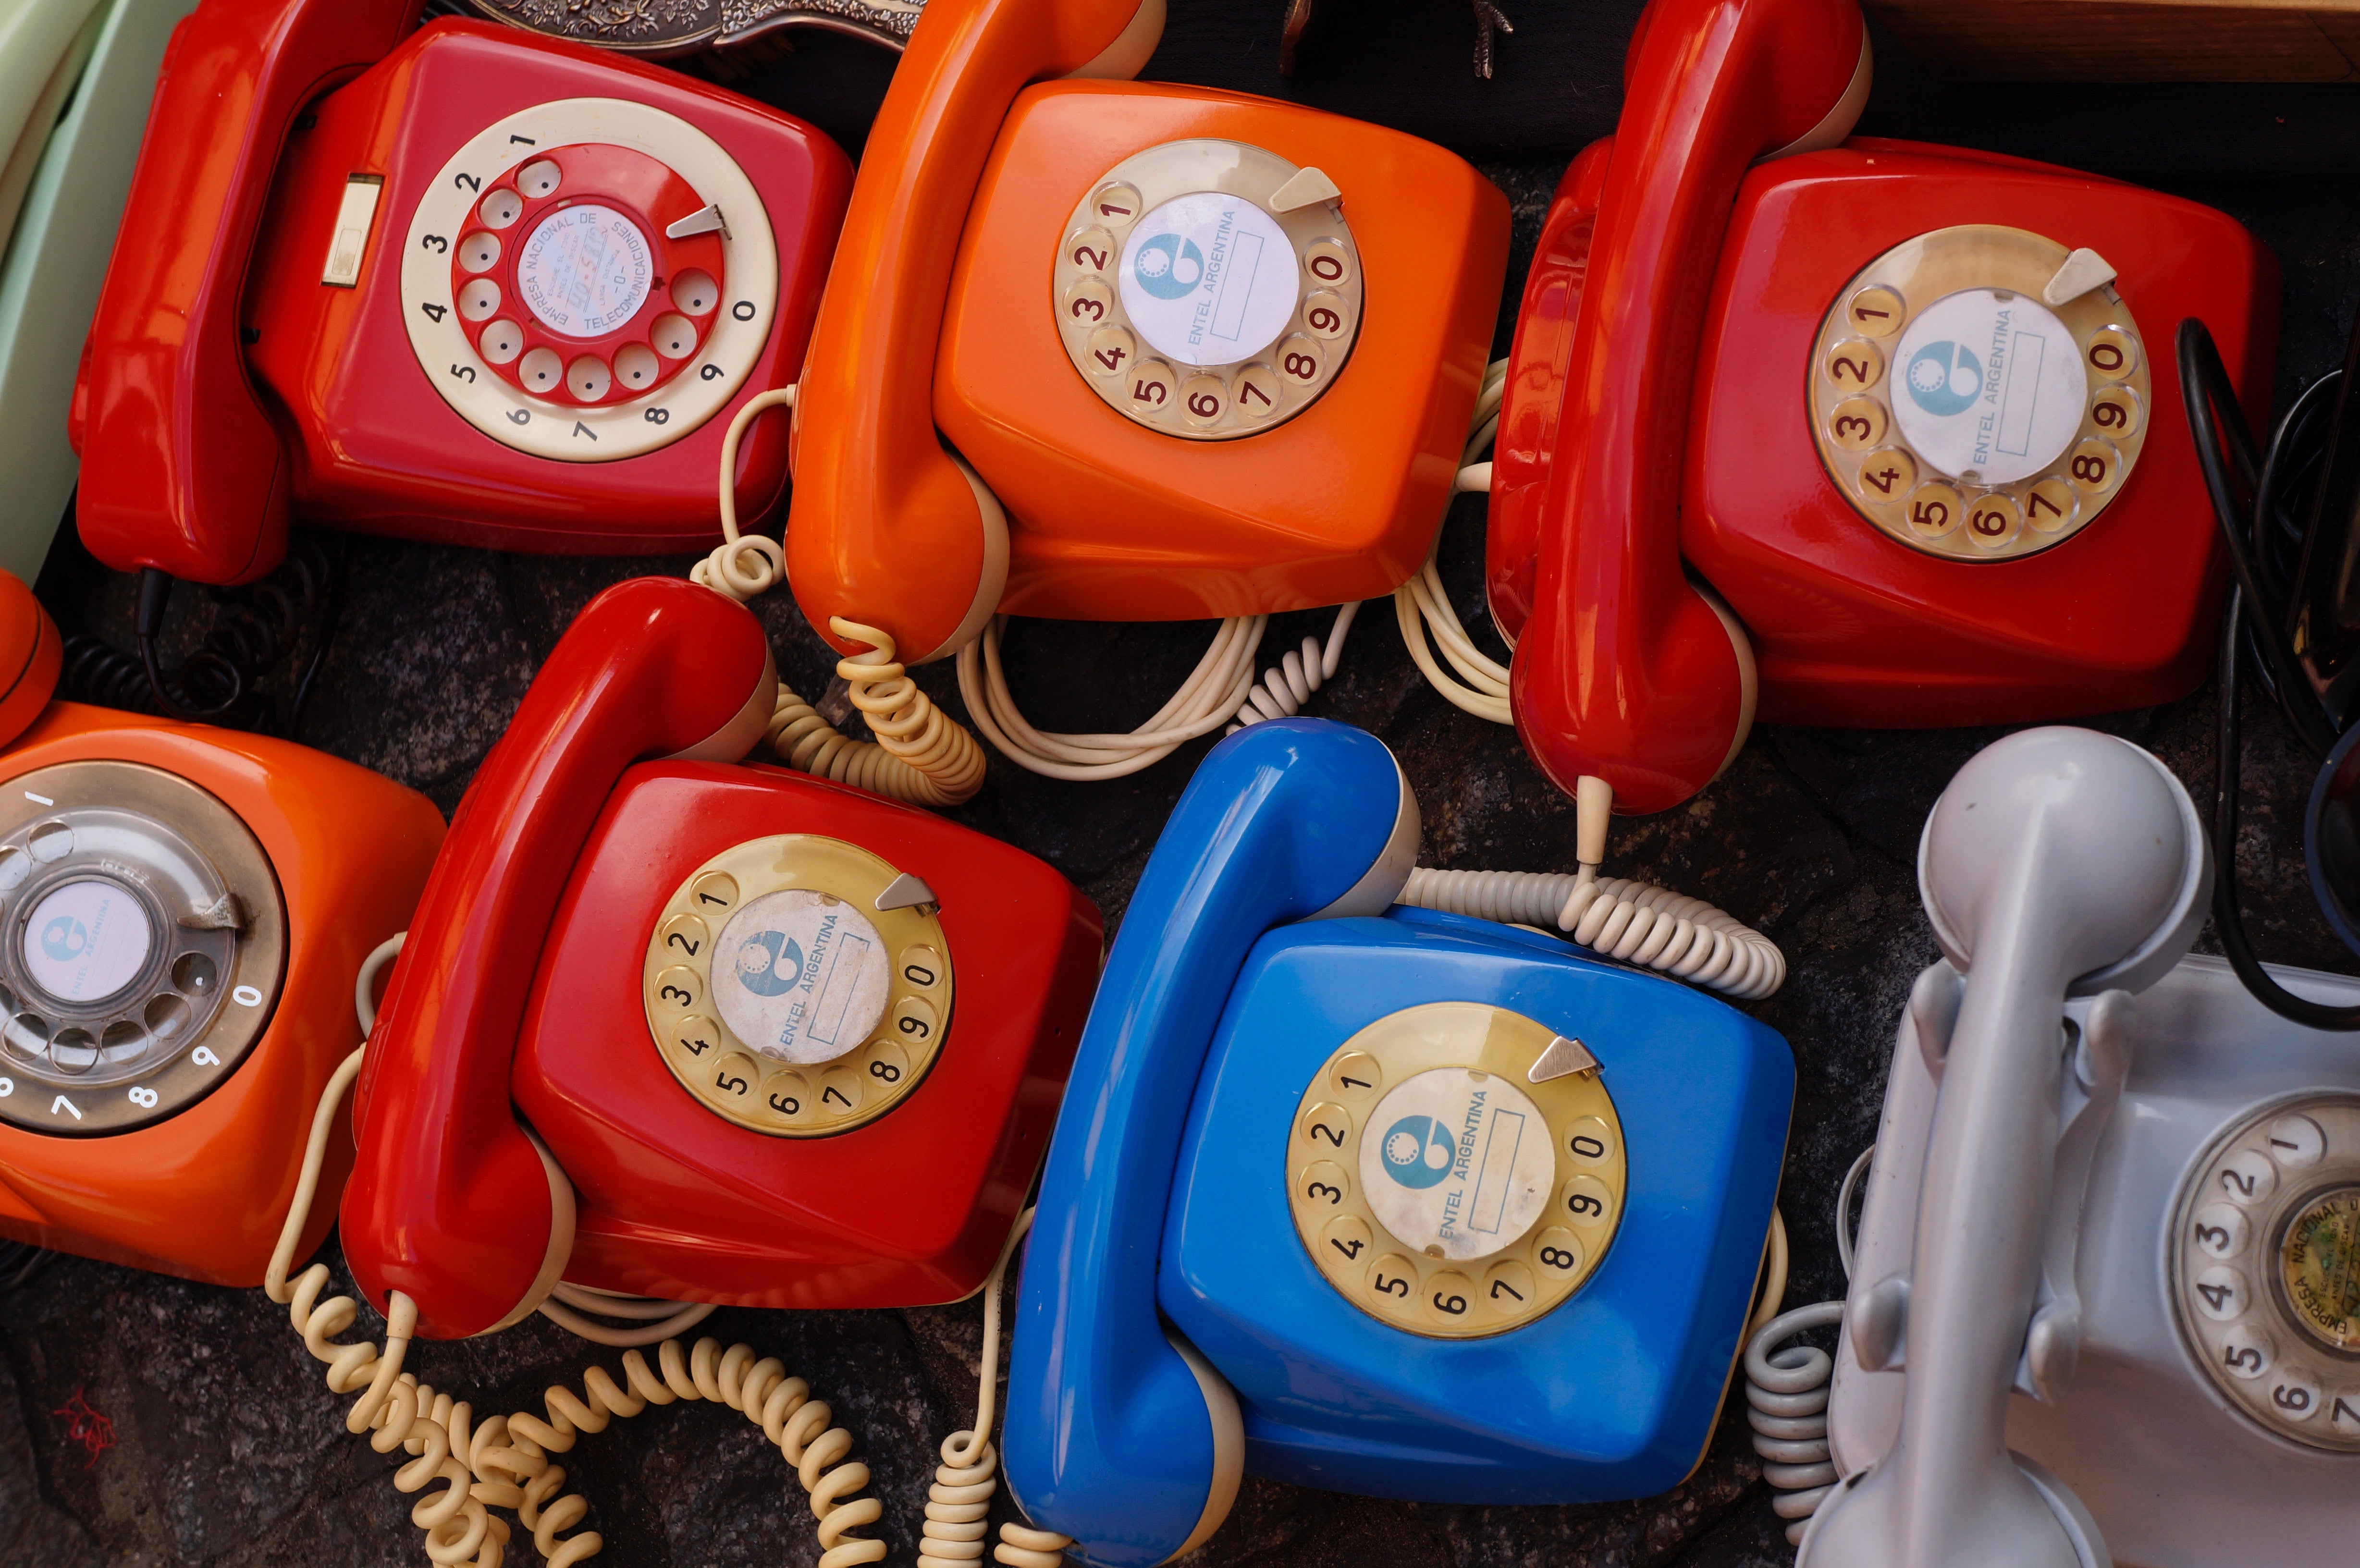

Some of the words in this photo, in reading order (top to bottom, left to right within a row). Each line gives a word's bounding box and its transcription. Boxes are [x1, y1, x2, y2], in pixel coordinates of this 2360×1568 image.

[510, 135, 536, 146] 1
[455, 173, 481, 193] 2
[580, 213, 596, 224] DE
[1100, 203, 1131, 217] 1
[422, 234, 448, 254] 3
[526, 217, 574, 270] NACIONAL
[565, 265, 572, 273] DE
[1074, 246, 1108, 271] 2
[1311, 256, 1343, 281] 0
[584, 221, 645, 330] TELECOMUNICACIONES
[1188, 299, 1212, 345] ENTEL
[1203, 210, 1235, 293] ARGENTINA
[421, 302, 448, 323] 4
[527, 276, 568, 325] EMPRESA
[732, 301, 756, 321] 0
[1072, 298, 1104, 322] 3
[1309, 307, 1340, 333] 9
[1855, 307, 1890, 321] 1
[1094, 347, 1126, 371] 4
[1284, 352, 1316, 380] 8
[2089, 343, 2123, 371] 0
[450, 364, 476, 384] 5
[700, 364, 725, 381] 9
[1832, 357, 1868, 383] 2
[1133, 380, 1167, 405] 5
[1239, 380, 1271, 407] 7
[1972, 412, 1995, 465] ENTEL
[1984, 309, 2011, 405] ARGENTINA
[644, 407, 669, 425] 8
[1188, 392, 1219, 417] 6
[2092, 402, 2127, 429] 9
[505, 409, 531, 426] 6
[1835, 416, 1871, 441] 3
[572, 420, 598, 441] 7
[1865, 467, 1900, 494] 4
[2071, 455, 2106, 484] 8
[1913, 501, 1948, 527] 5
[2028, 492, 2062, 518] 7
[1972, 509, 2006, 536] 6
[699, 893, 728, 906] 1
[25, 791, 54, 807] 1
[51, 1095, 82, 1121] 7
[128, 1086, 158, 1108] 8
[192, 1046, 220, 1066] 9
[233, 985, 262, 1007] 0
[71, 967, 88, 995] ENTEL
[85, 899, 111, 957] ARGENTINA
[667, 933, 700, 956] 2
[779, 1000, 806, 1046] ENTEL
[802, 914, 838, 994] ARGENTINA
[904, 965, 935, 986] 0
[661, 985, 692, 1007] 3
[898, 1016, 929, 1038] 9
[680, 1039, 710, 1056] 4
[716, 1072, 748, 1095] 5
[869, 1060, 900, 1082] 8
[1340, 1076, 1372, 1089] 1
[769, 1093, 799, 1115] 6
[822, 1086, 852, 1107] 7
[1311, 1123, 1345, 1148] 2
[1570, 1136, 1604, 1158] 0
[2270, 1138, 2299, 1151] 1
[1438, 1189, 1463, 1240] ENTEL
[1453, 1090, 1487, 1181] ARGENTINA
[1308, 1182, 1341, 1205] 3
[2219, 1169, 2255, 1197] 2
[1568, 1194, 1602, 1217] 9
[2193, 1223, 2230, 1251] 3
[2291, 1202, 2341, 1263] NACIONAL
[1331, 1238, 1364, 1260] 4
[1540, 1246, 1574, 1270] 8
[1375, 1273, 1409, 1298] 5
[1490, 1279, 1524, 1301] 7
[2331, 1274, 2341, 1299] ANTES
[2336, 1260, 2344, 1270] DE
[1433, 1292, 1467, 1315] 6
[2196, 1283, 2233, 1311] 4
[2294, 1275, 2347, 1335] EMPRESA
[2224, 1346, 2262, 1372] 5
[2273, 1384, 2310, 1411] 6
[2331, 1397, 2360, 1424] 7
